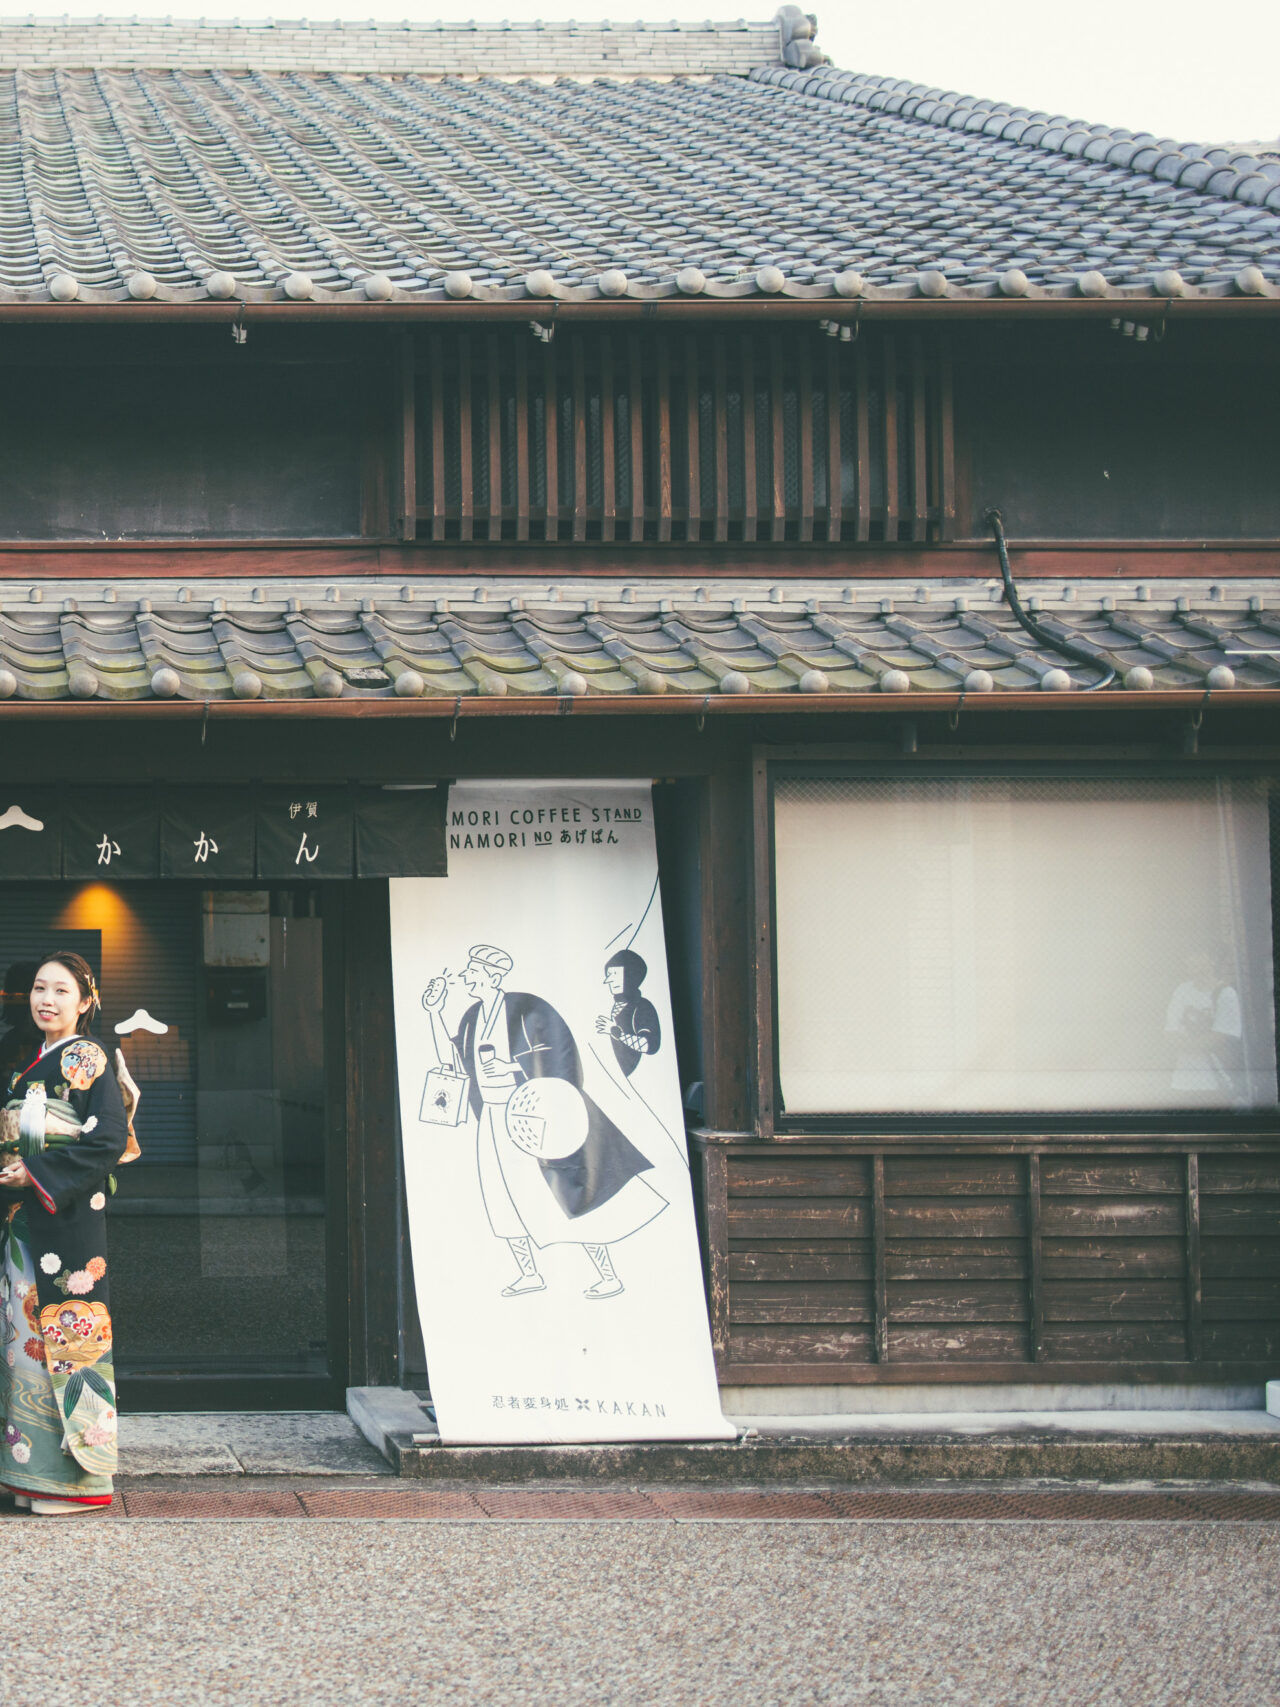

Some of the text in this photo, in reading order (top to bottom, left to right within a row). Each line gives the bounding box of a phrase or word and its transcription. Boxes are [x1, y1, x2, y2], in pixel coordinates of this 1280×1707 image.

[289, 801, 318, 819] 伊賀
[446, 807, 642, 826] MORI COFFEE STAND
[533, 830, 553, 846] NO
[560, 828, 619, 844] あげぱん
[596, 1399, 666, 1418] KAKAN
